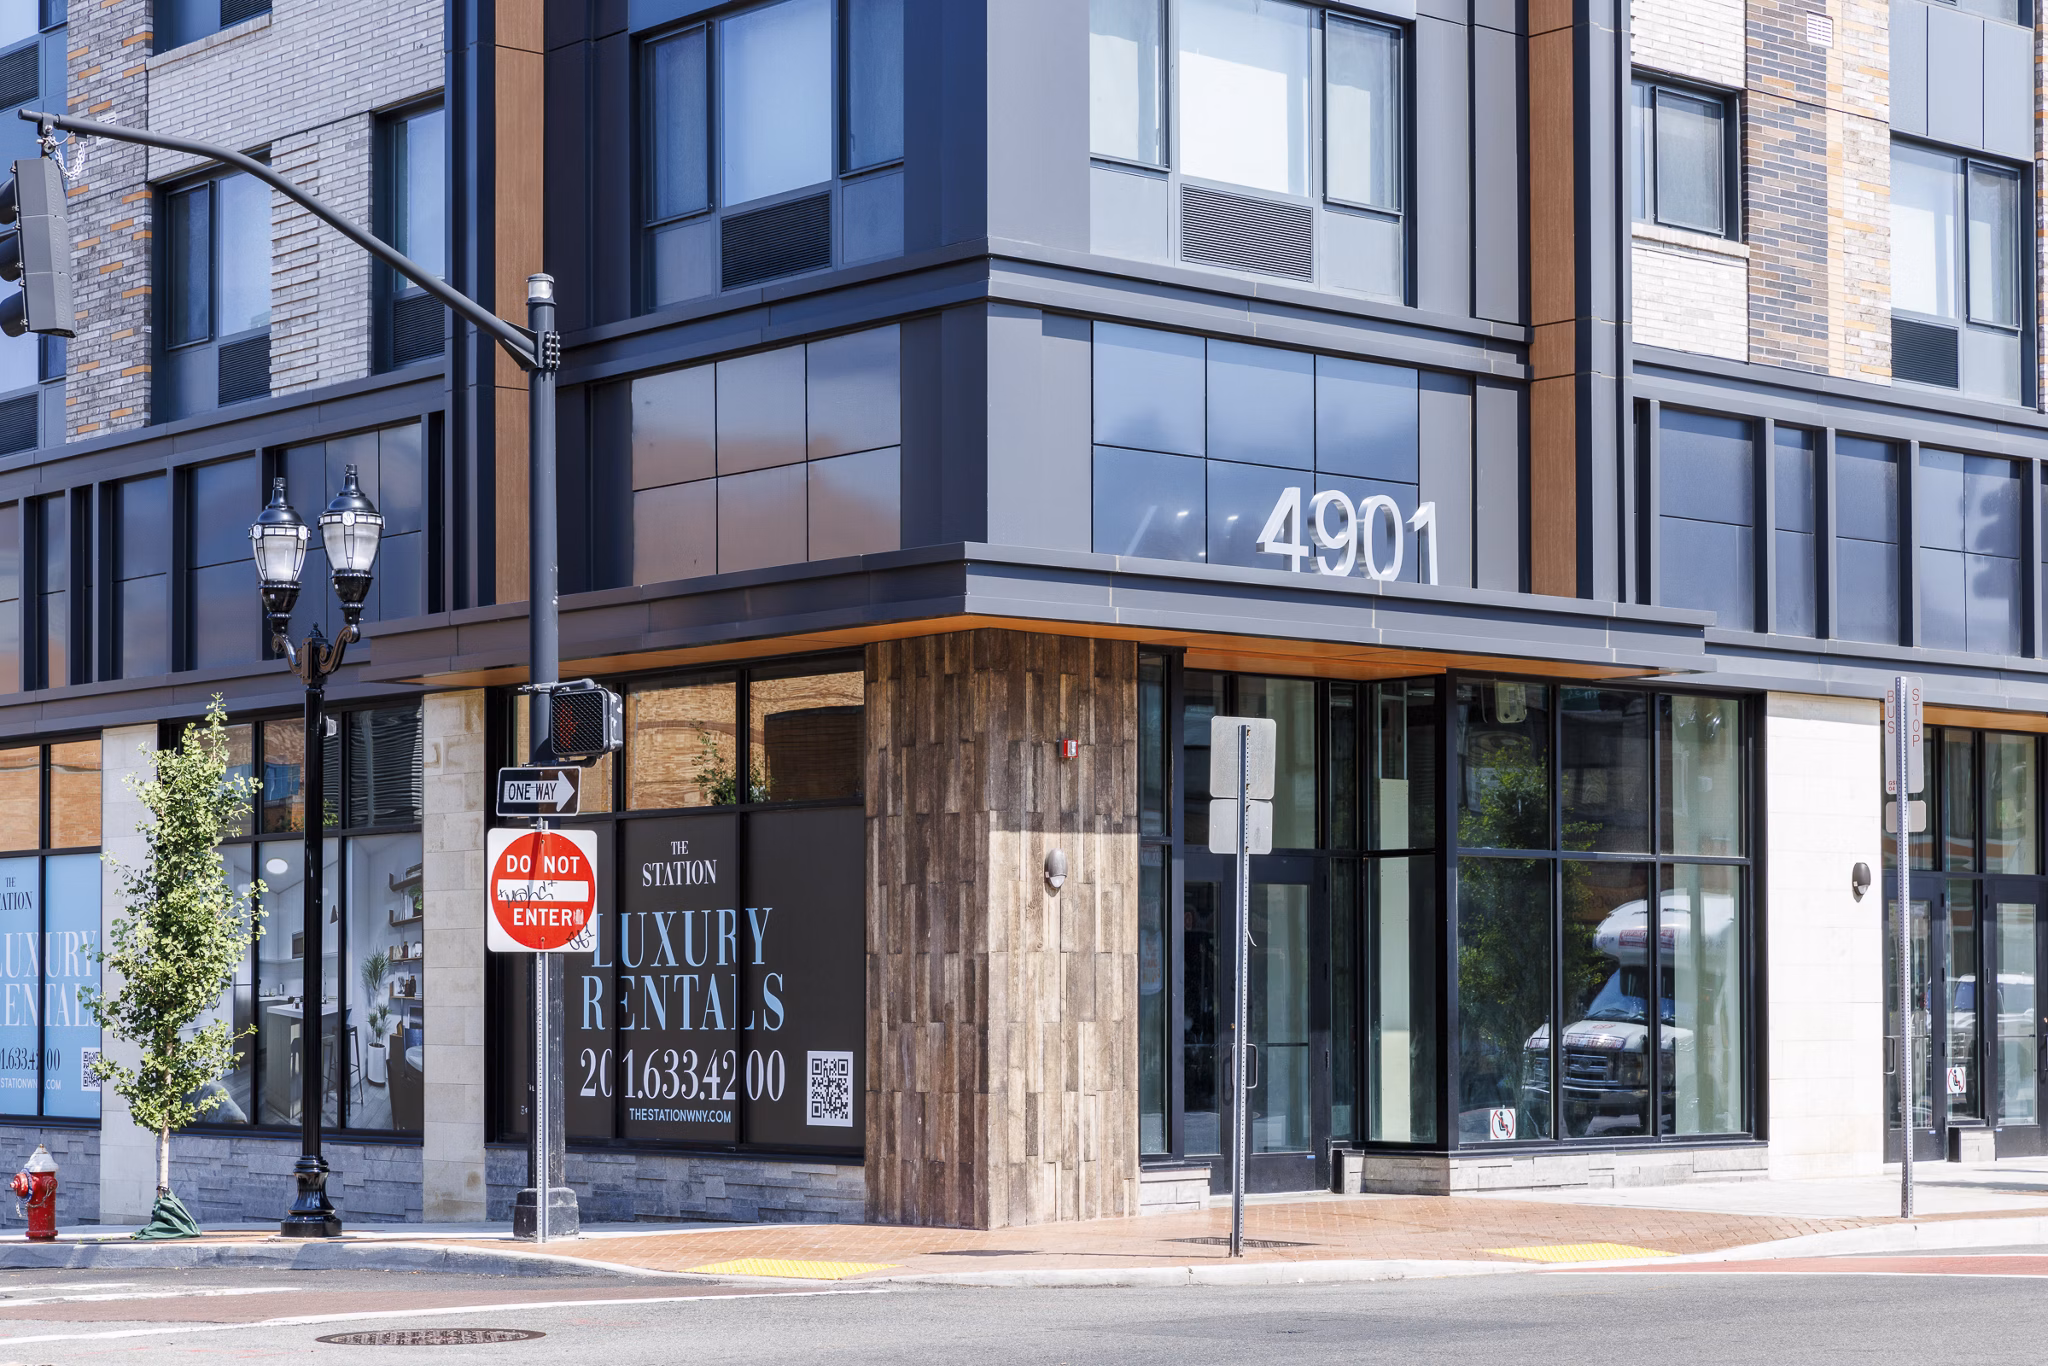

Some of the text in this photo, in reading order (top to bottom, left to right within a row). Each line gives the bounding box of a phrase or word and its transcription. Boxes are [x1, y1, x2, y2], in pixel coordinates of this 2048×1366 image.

[1256, 486, 1438, 585] 4901
[1887, 688, 1920, 747] BUS STOP
[508, 782, 557, 800] ONE WAY
[671, 841, 689, 855] THE
[506, 855, 580, 874] DO NOT
[642, 859, 717, 887] STATION
[6, 877, 16, 887] THE
[0, 891, 33, 910] ATION
[513, 908, 572, 926] ENTER
[591, 907, 773, 968] LUXURY
[0, 930, 97, 978] UXURY
[629, 1107, 731, 1123] THESTATIONWNY.COM
